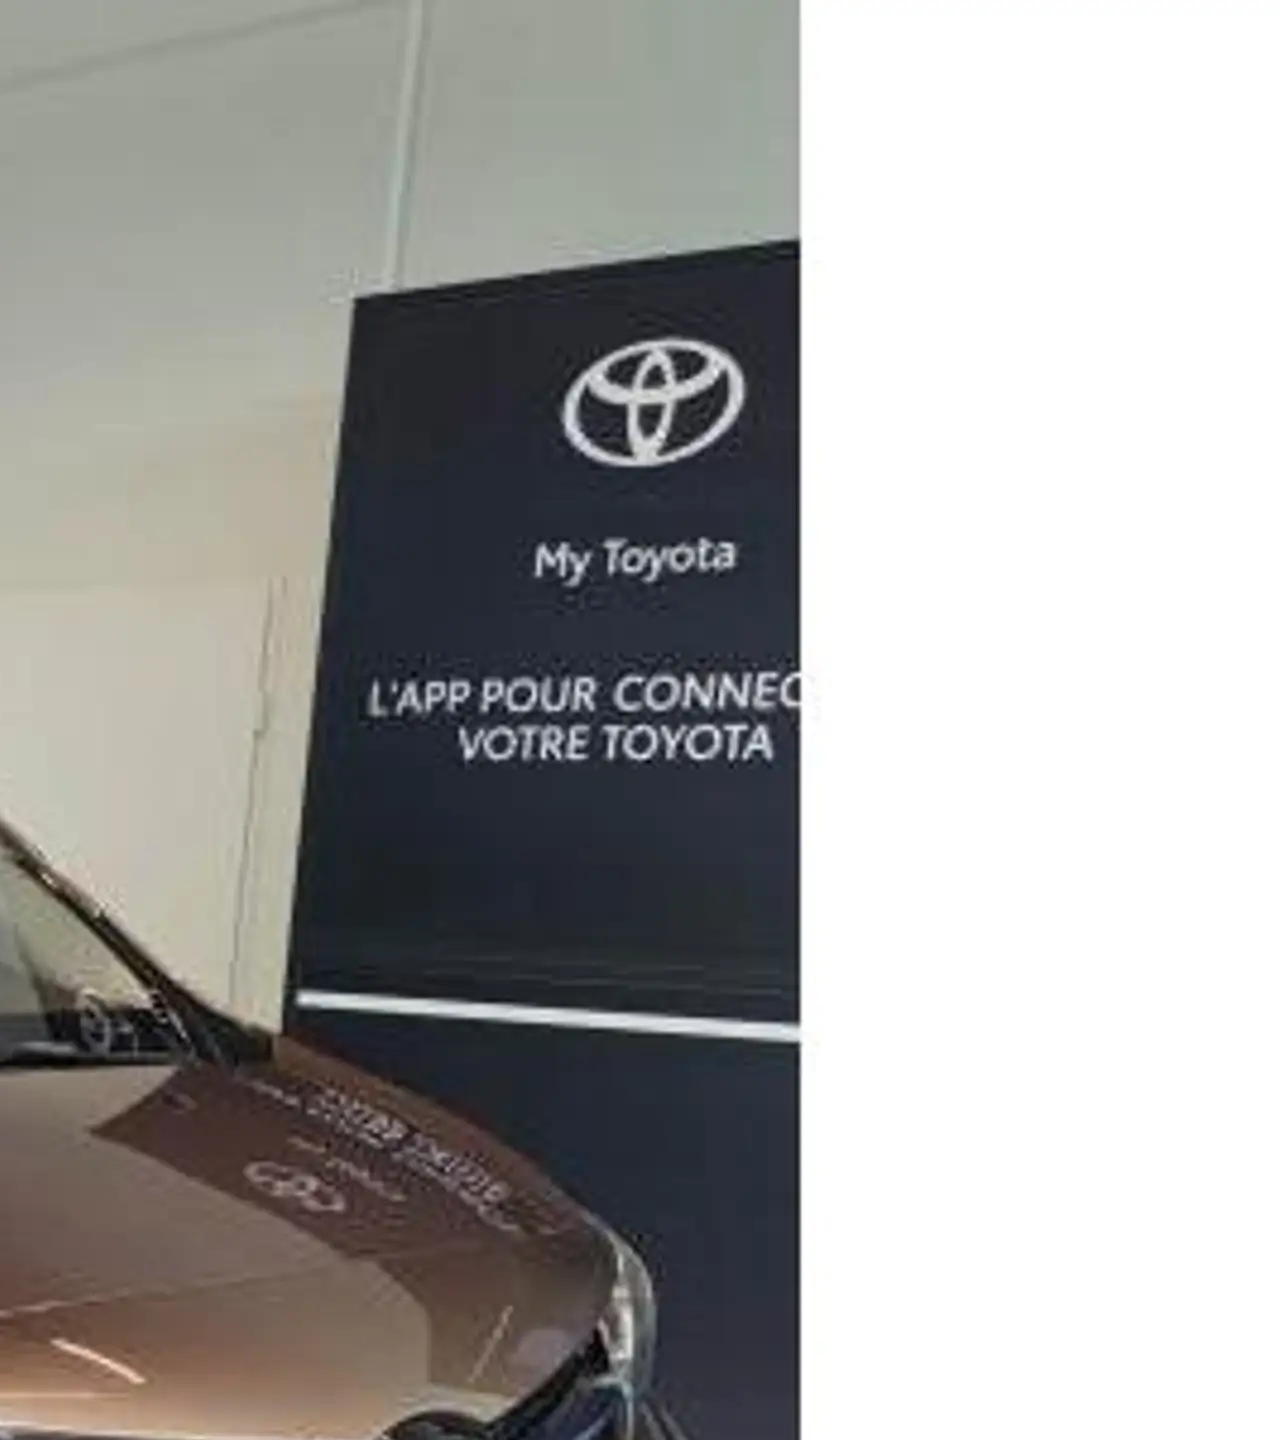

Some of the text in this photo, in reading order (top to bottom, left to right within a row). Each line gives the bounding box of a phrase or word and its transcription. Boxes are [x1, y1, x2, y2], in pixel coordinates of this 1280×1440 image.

[535, 538, 738, 587] My Toyota
[367, 669, 801, 718] L'APP POUR CONNEC
[458, 724, 775, 762] VOTRE TOYOTA
